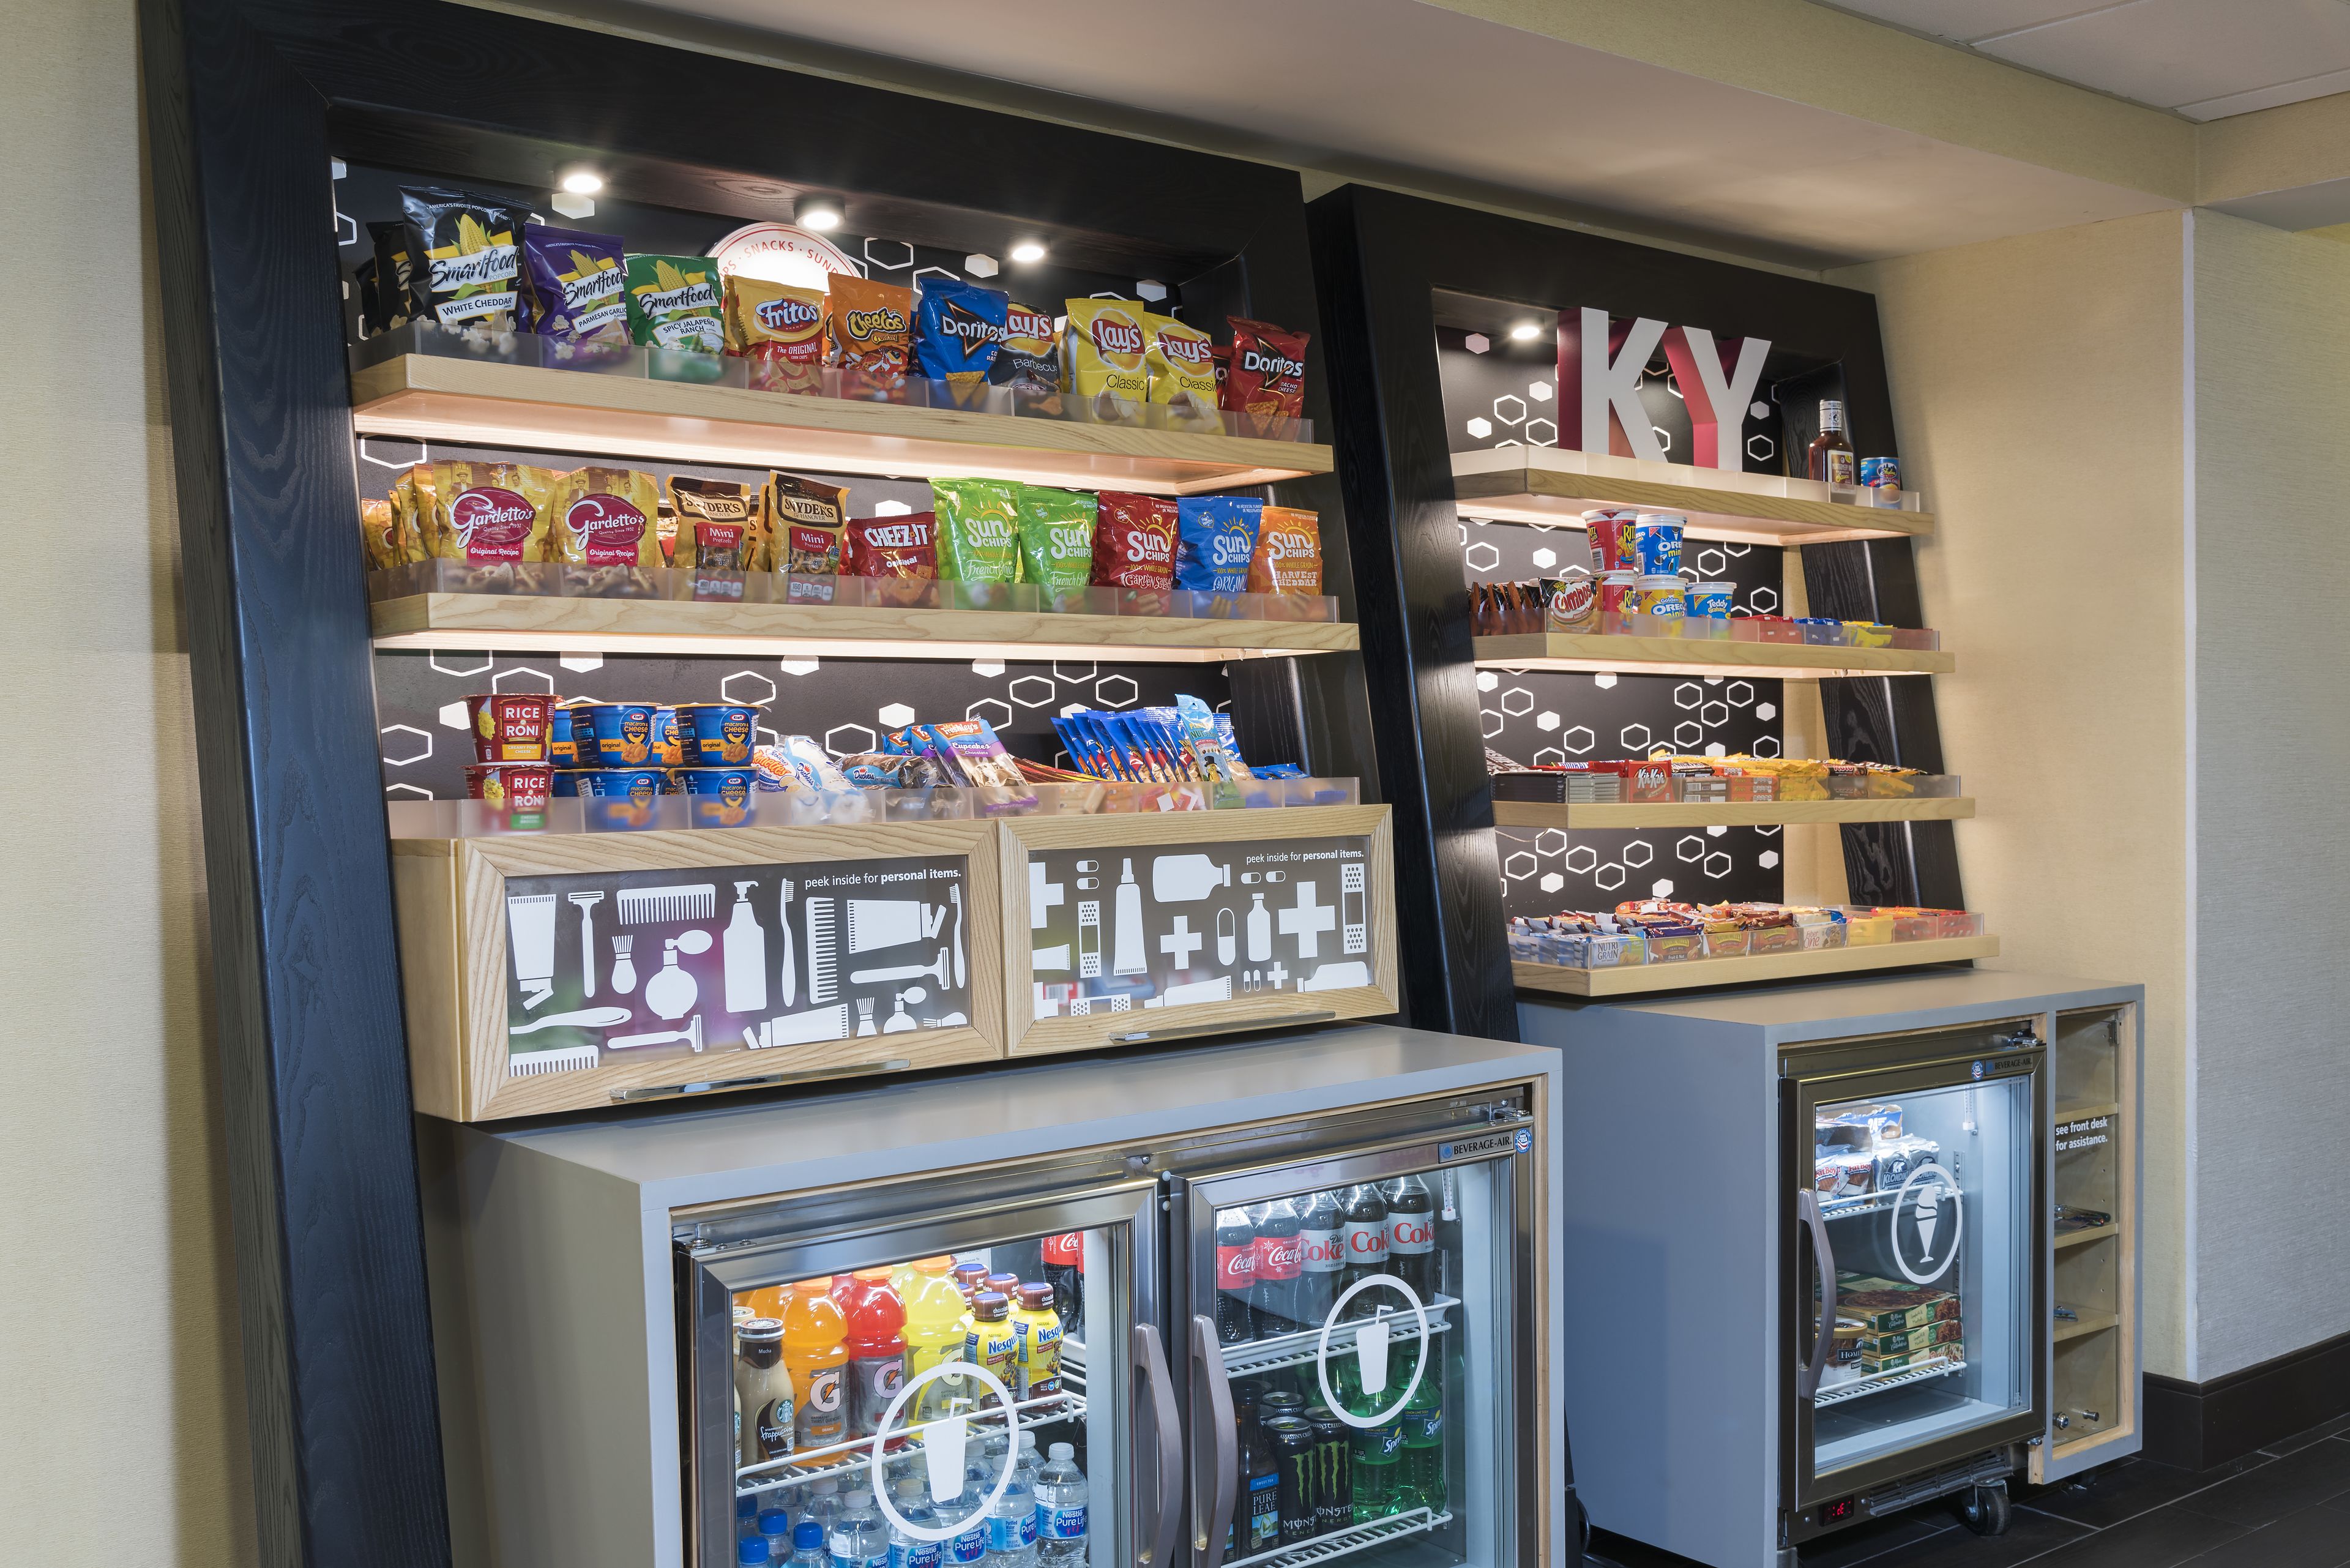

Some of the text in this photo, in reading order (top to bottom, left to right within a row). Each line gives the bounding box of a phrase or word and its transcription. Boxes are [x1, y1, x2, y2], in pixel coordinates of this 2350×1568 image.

[472, 205, 493, 215] POPCORN
[744, 240, 794, 258] SNACKS
[429, 246, 519, 289] Smartfood
[490, 270, 516, 280] POPCORN
[563, 271, 624, 306] Smartfood
[442, 297, 512, 316] WHITE CHEDDAR
[639, 283, 713, 318] Smartfood
[579, 307, 627, 327] PARMESAN GARLIC
[755, 298, 818, 329] Fritos
[663, 318, 715, 334] SPICY JALAPEÑO
[681, 325, 704, 335] RANCH
[848, 308, 906, 338] Cheetos
[871, 334, 898, 344] Crunchy
[1097, 320, 1141, 354] Lay's
[788, 342, 818, 354] ORIGINAL
[1162, 332, 1212, 364] Lay's
[1245, 351, 1304, 377] Doritos
[1106, 374, 1145, 391] Classic
[1581, 307, 1772, 472] KY
[785, 498, 834, 518] SNYDER'S
[450, 493, 534, 548] Gardetto's
[565, 500, 644, 551] Gardetto's
[710, 528, 734, 538] Mini
[801, 532, 824, 543] Mini
[965, 518, 1011, 547] Sun
[982, 538, 1012, 548] CHIPS
[1050, 528, 1091, 559] Sun
[1127, 531, 1171, 562] Sun
[1268, 531, 1314, 560] Sun
[471, 547, 520, 557] Original Recipe
[589, 549, 635, 558] Original Recipe
[1067, 547, 1092, 558] CHIPS
[1145, 551, 1169, 562] CHIPS
[1212, 535, 1251, 566] Sun
[1286, 549, 1315, 558] CHIPS
[1668, 549, 1681, 558] min
[1228, 554, 1250, 563] CHIPS
[1554, 584, 1592, 613] Combos
[1707, 599, 1728, 608] Teddy
[1653, 604, 1683, 614] OREO
[505, 707, 540, 719] RICE
[506, 725, 539, 736] RONI
[952, 742, 991, 751] Cupcakes
[797, 762, 814, 785] Duchess
[854, 769, 875, 780] Duchess
[514, 777, 545, 789] RICE
[515, 796, 544, 807] RONI
[1246, 849, 1365, 865] peek inside for personal items.
[805, 868, 961, 890] peek inside for personal items.
[1807, 930, 1819, 939] Fiber
[1598, 942, 1618, 952] NUTRI
[1804, 936, 1819, 949] One
[1598, 949, 1619, 960] GRAIN
[1994, 1058, 2031, 1070] BEVERAGE-AIR
[2056, 1116, 2108, 1135] see front desk
[1454, 1136, 1510, 1155] BEVERAGE-AIR
[2056, 1135, 2108, 1151] for assistance.
[1882, 1171, 1908, 1187] KLONDIK
[1329, 1234, 1343, 1244] Diet
[1301, 1238, 1344, 1261] Coke
[873, 1360, 904, 1398] G
[810, 1371, 840, 1412] G
[1253, 1491, 1277, 1506] PURE
[1063, 1509, 1083, 1518] Nestlé
[1253, 1501, 1275, 1515] LEAF
[1056, 1515, 1087, 1528] Pure Life
[1021, 1523, 1034, 1535] Pure
[961, 1531, 980, 1542] Nestlé
[916, 1546, 938, 1556] Nestlé
[955, 1537, 985, 1551] Pure Life
[909, 1551, 942, 1565] Pure Life
